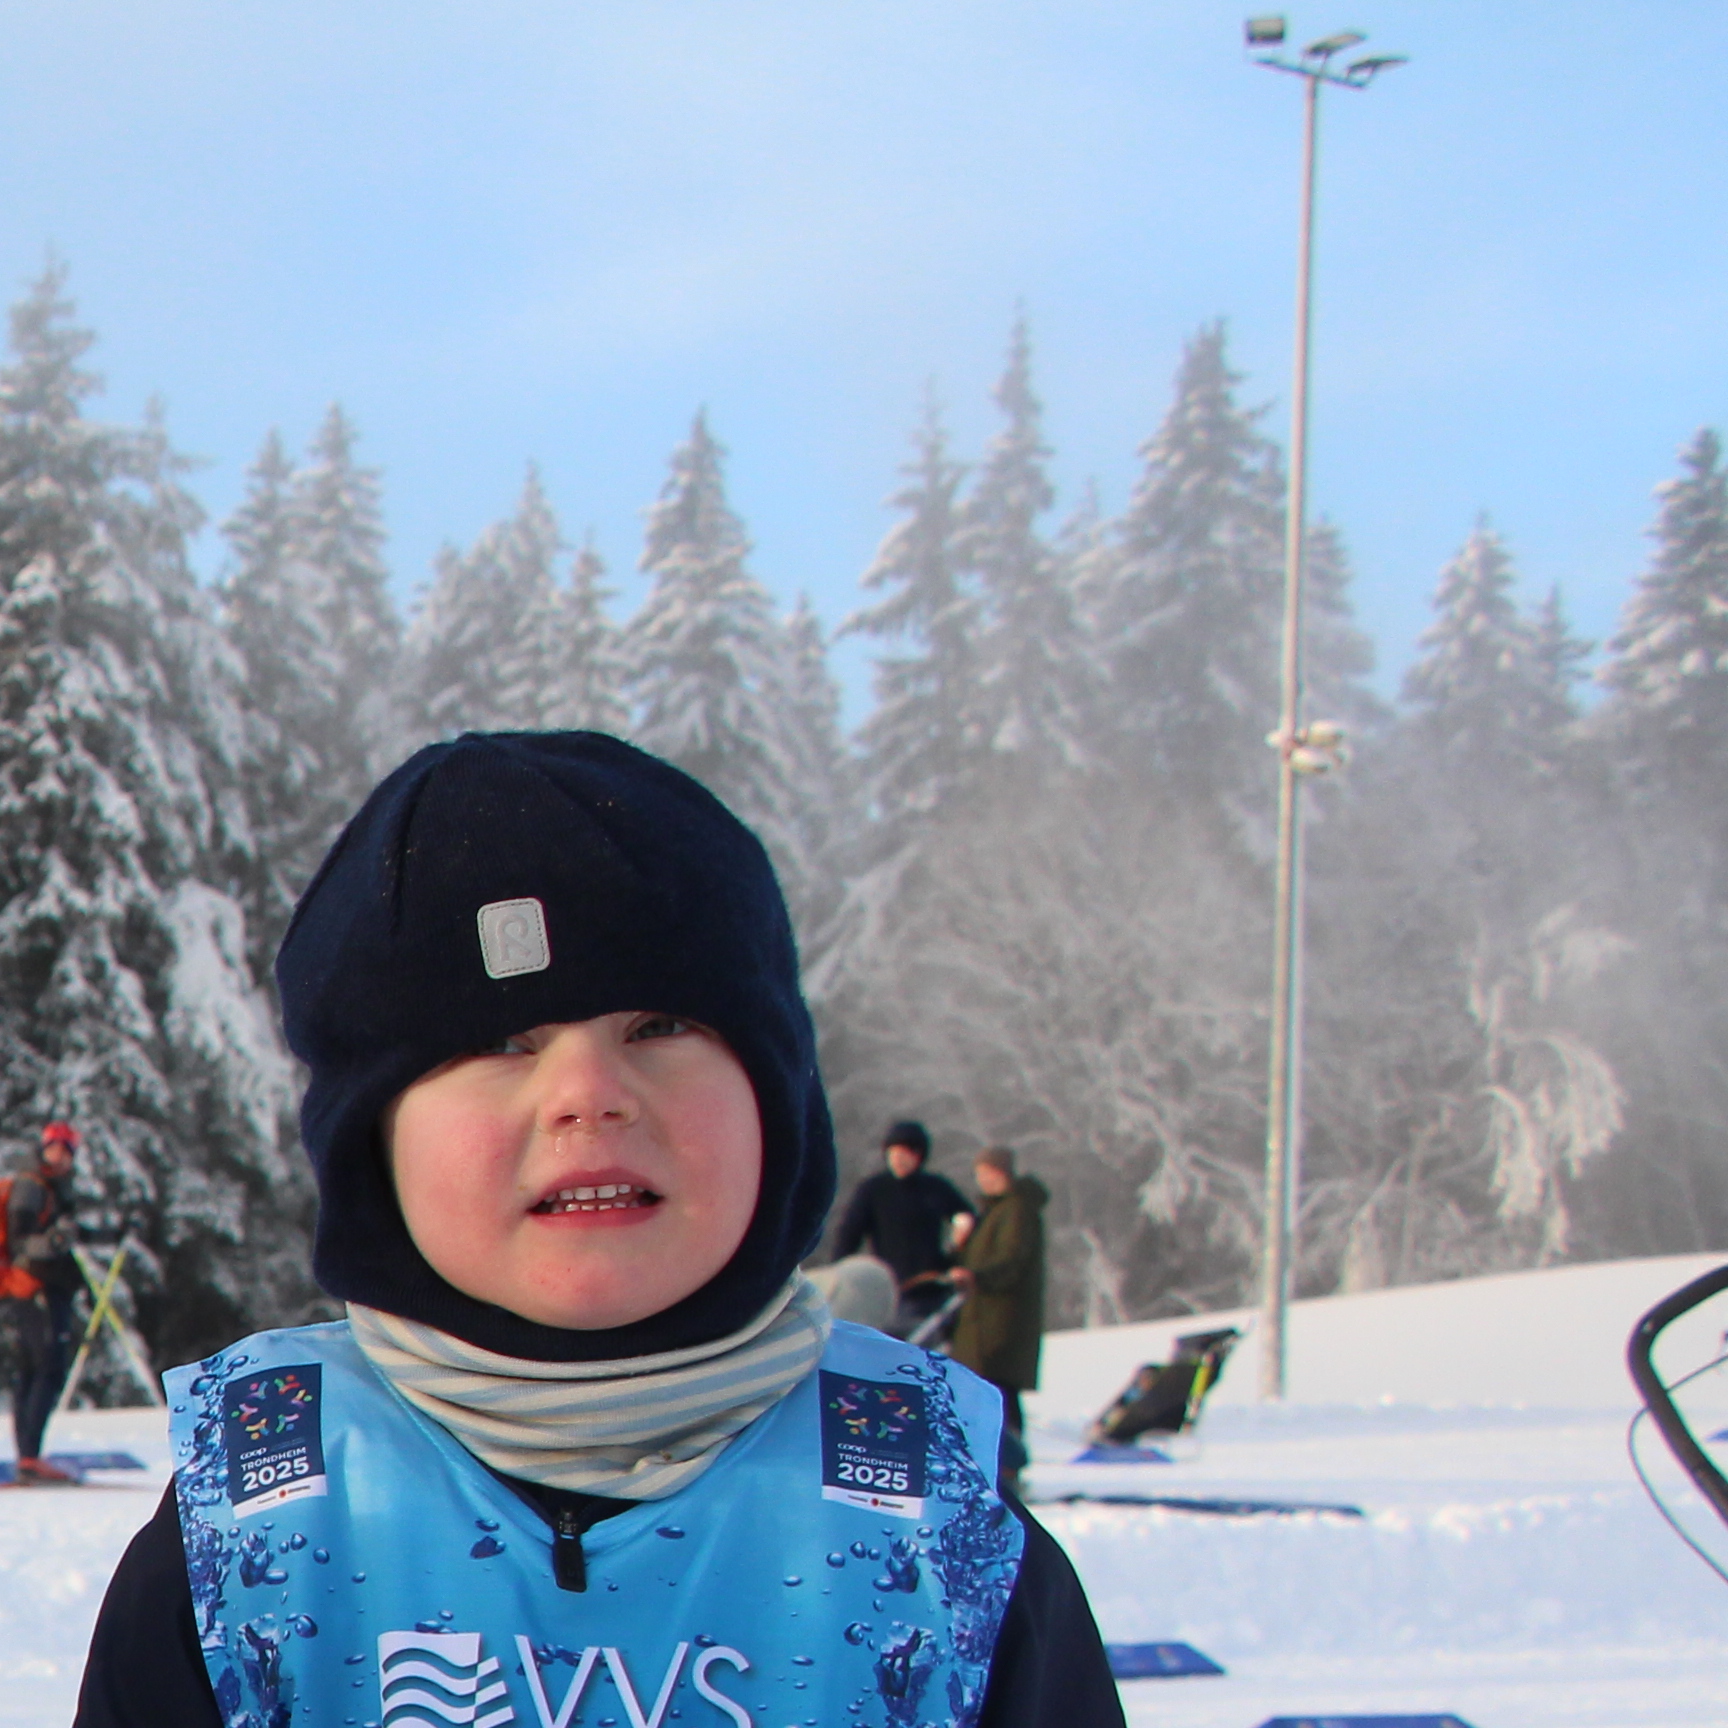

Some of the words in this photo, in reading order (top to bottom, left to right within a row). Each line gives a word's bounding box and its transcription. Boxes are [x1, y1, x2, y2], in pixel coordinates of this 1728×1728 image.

[240, 1446, 307, 1472] TRONDHEIM
[838, 1453, 909, 1471] TRONDHEIM
[242, 1456, 310, 1493] 2025
[837, 1462, 909, 1492] 2025
